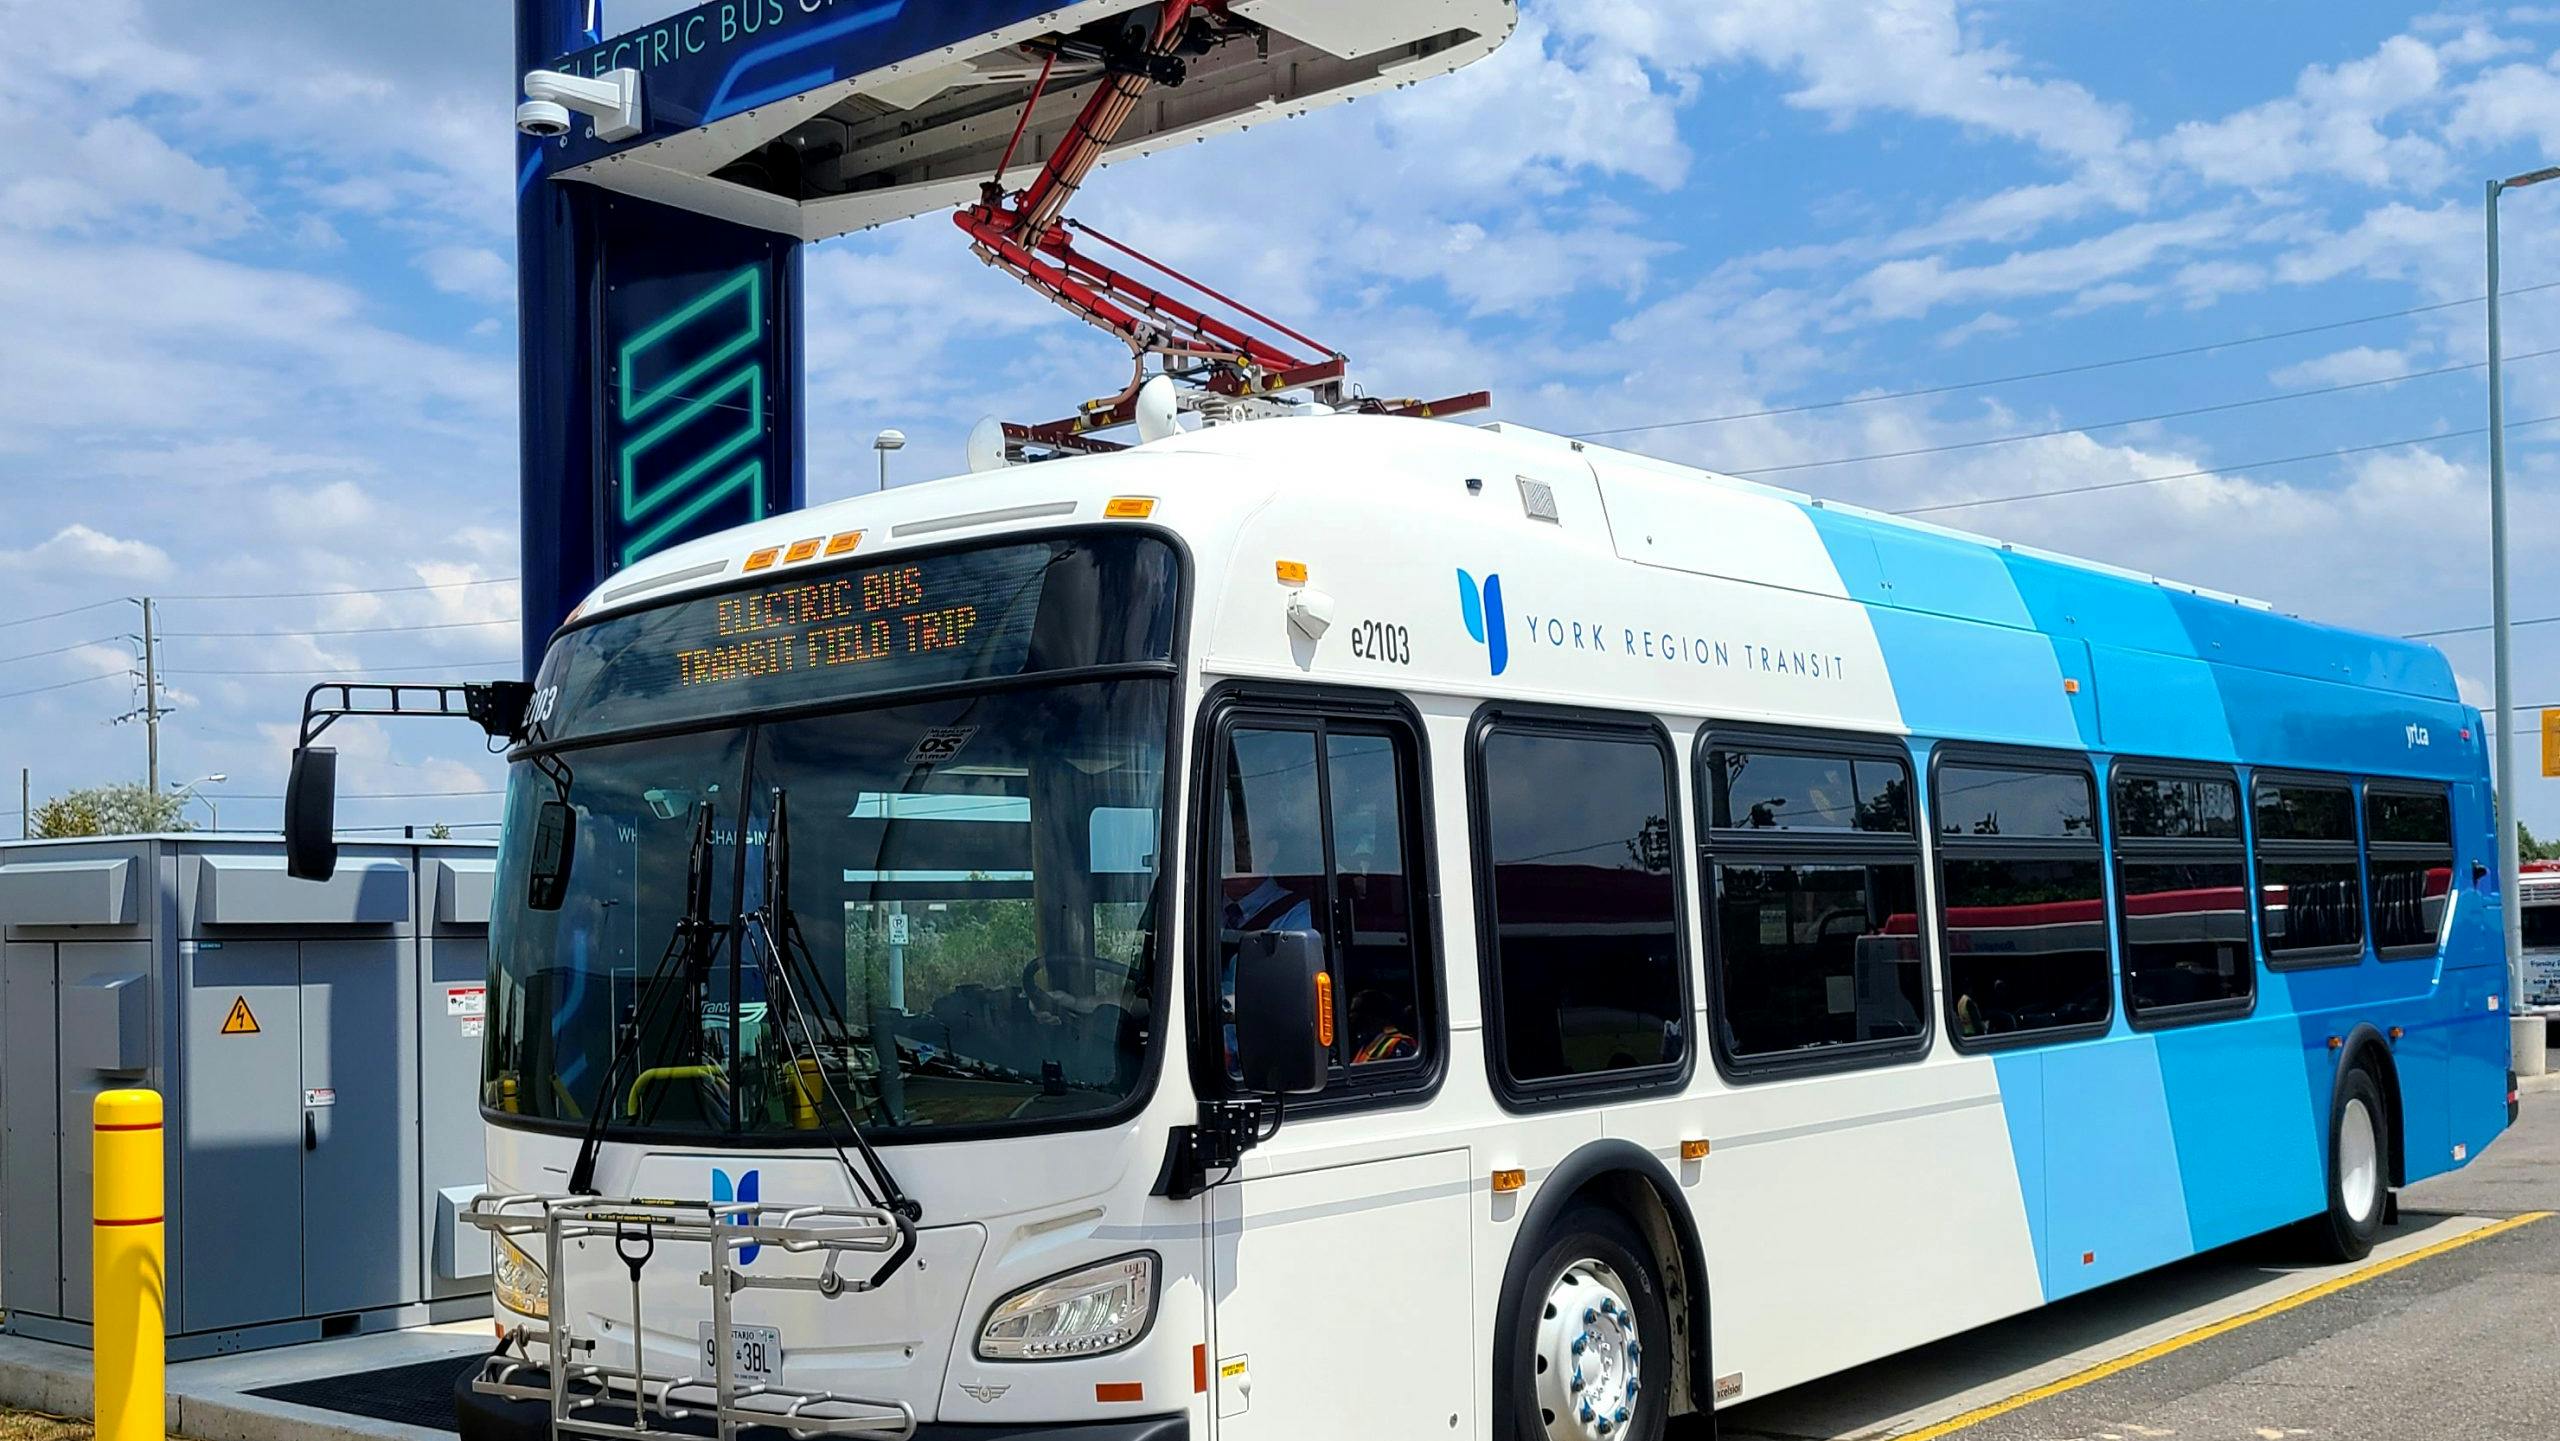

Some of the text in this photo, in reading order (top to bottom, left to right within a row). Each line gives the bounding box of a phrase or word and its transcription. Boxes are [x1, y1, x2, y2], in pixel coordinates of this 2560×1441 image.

[558, 0, 784, 78] ECTRIC BUS
[717, 566, 922, 636] ELECTRIC BUS
[676, 605, 977, 686] TRANSIT FIELD TRIP
[1351, 619, 1411, 665] e2103
[1525, 614, 1845, 681] YORK REGION TRANSIT
[521, 684, 558, 728] 2103
[2405, 723, 2429, 749] yrt.ca
[731, 1330, 755, 1341] TARIO
